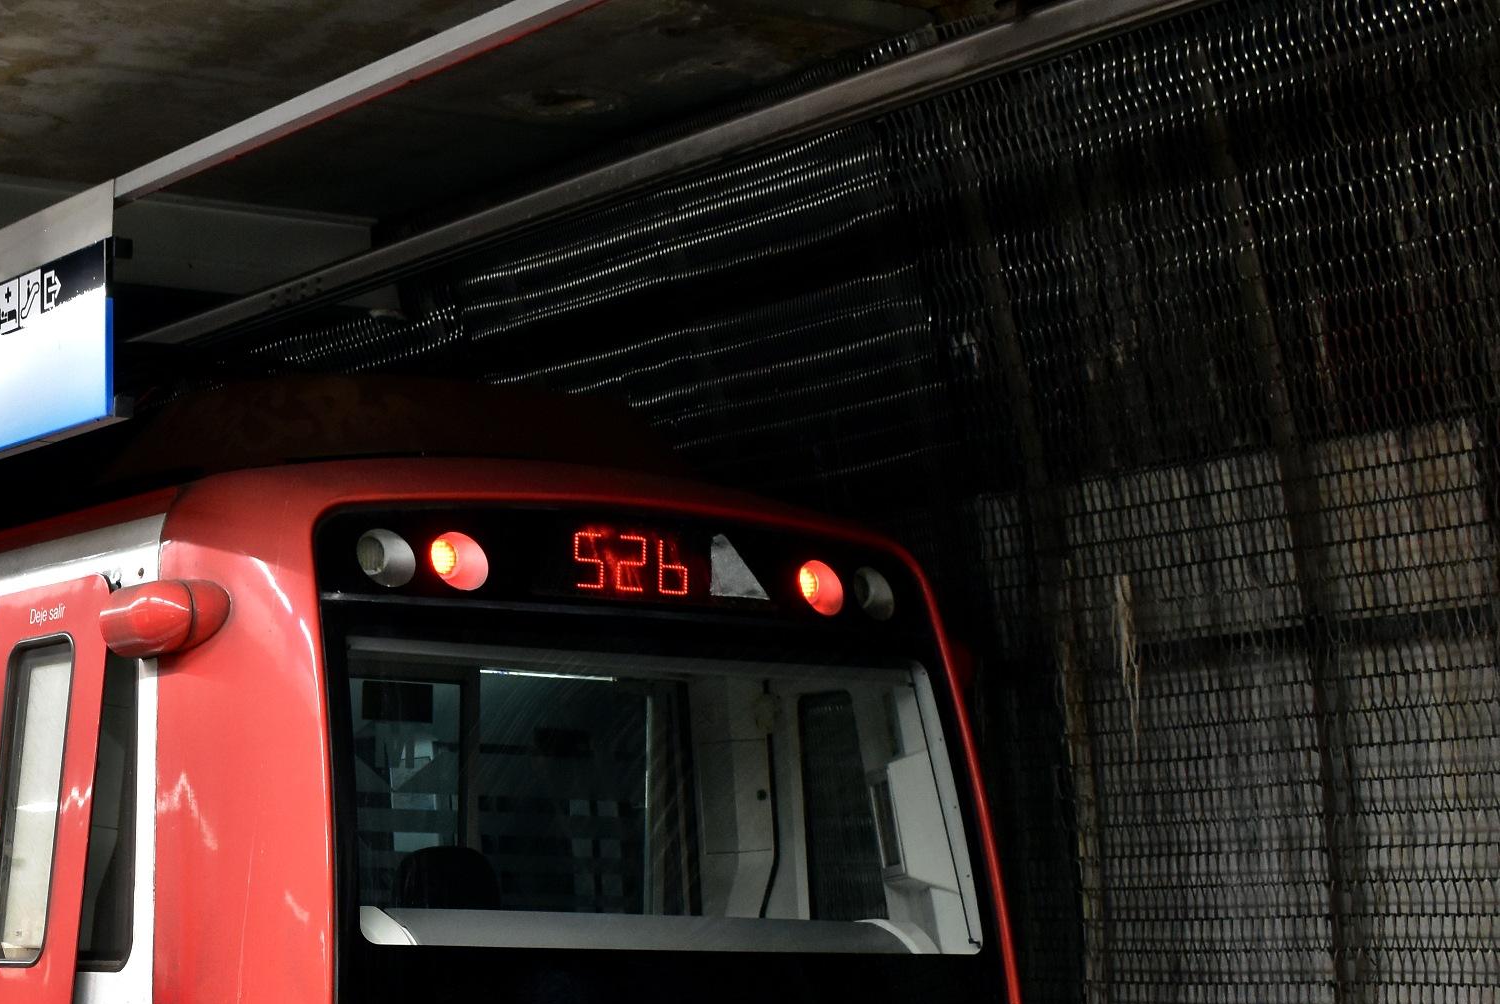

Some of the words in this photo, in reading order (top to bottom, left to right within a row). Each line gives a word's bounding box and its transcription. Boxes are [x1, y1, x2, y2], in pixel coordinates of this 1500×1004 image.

[574, 531, 689, 596] 526
[29, 608, 48, 627] Deje
[49, 602, 66, 621] salir
